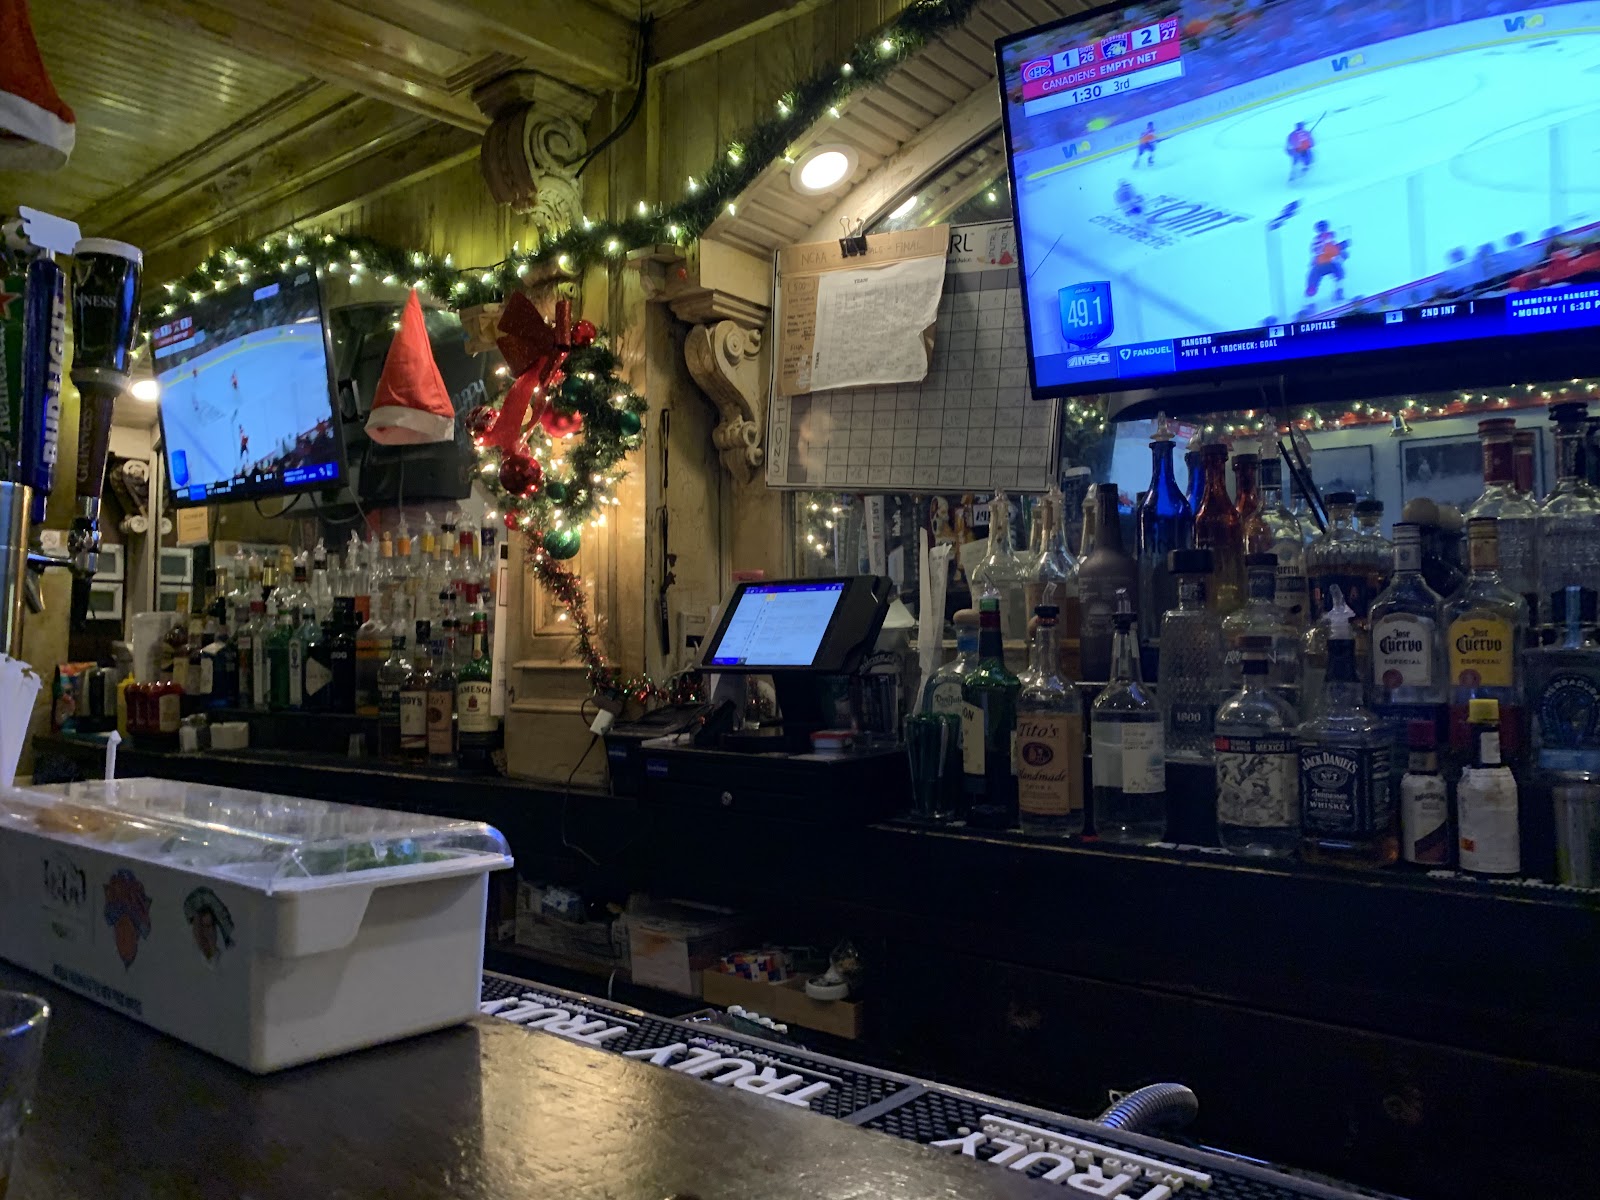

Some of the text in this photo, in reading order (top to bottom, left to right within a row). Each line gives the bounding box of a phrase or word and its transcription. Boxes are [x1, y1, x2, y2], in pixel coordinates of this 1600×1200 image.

[1140, 27, 1177, 45] 2 27
[1062, 52, 1095, 67] 1 26
[1042, 50, 1158, 91] CANADIENS EMPTY NET
[1071, 79, 1131, 104] 1:30 3rd
[801, 251, 827, 266] NCAA
[1512, 295, 1552, 307] MAMMOTH
[1563, 289, 1600, 301] RANGERS
[1067, 296, 1103, 329] 49.1
[1518, 305, 1558, 318] MONDAY
[1569, 301, 1592, 313] 6:30
[1300, 320, 1336, 332] CAPITALS
[1421, 307, 1439, 318] 2ND
[1440, 305, 1456, 315] INT
[1181, 336, 1212, 348] RANGERS
[1259, 339, 1278, 349] GOAL
[1067, 352, 1110, 368] MSG
[1132, 346, 1171, 358] FANDUEL
[43, 294, 66, 465] BUD LIGHT
[1379, 635, 1422, 655] Cuervo
[1456, 634, 1502, 655] Cuervo
[459, 685, 492, 695] AMESO
[1176, 711, 1202, 723] 1800
[1018, 722, 1060, 738] Tito's
[1301, 752, 1358, 774] JACK DANIEL'S
[1309, 800, 1352, 811] WHISKEY
[622, 1042, 831, 1110] TRULY
